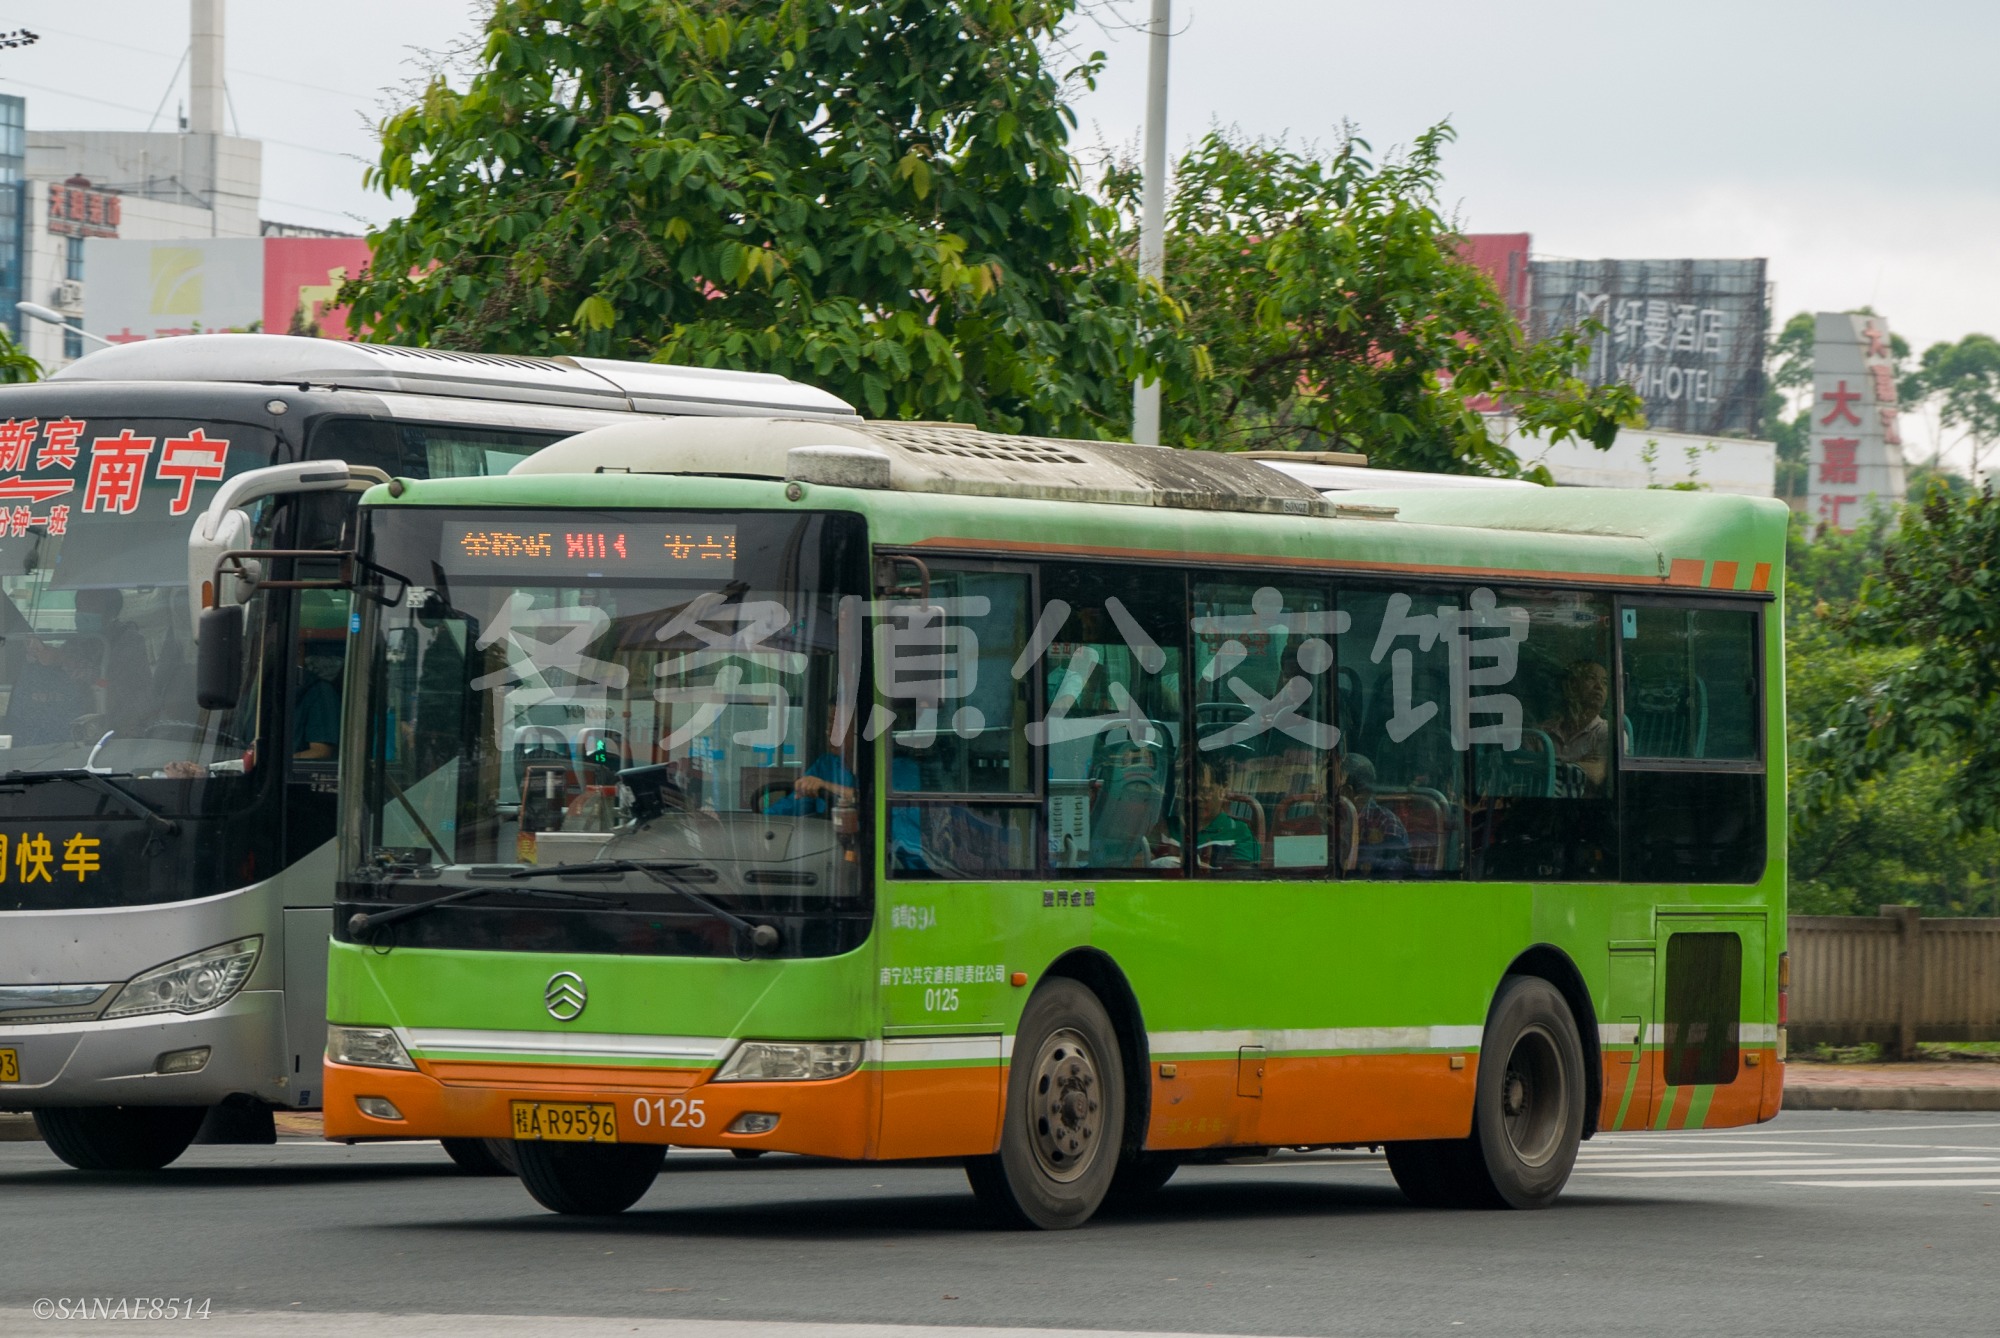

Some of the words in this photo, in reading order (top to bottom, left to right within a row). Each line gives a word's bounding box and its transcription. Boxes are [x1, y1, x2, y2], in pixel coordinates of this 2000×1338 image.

[81, 427, 230, 516] 南宁
[1819, 380, 1861, 535] 大嘉汇
[0, 832, 100, 883] 快车
[880, 964, 1005, 985] 南宁公共交通有限责任公司
[925, 988, 959, 1011] 0125
[633, 1097, 706, 1128] 0125
